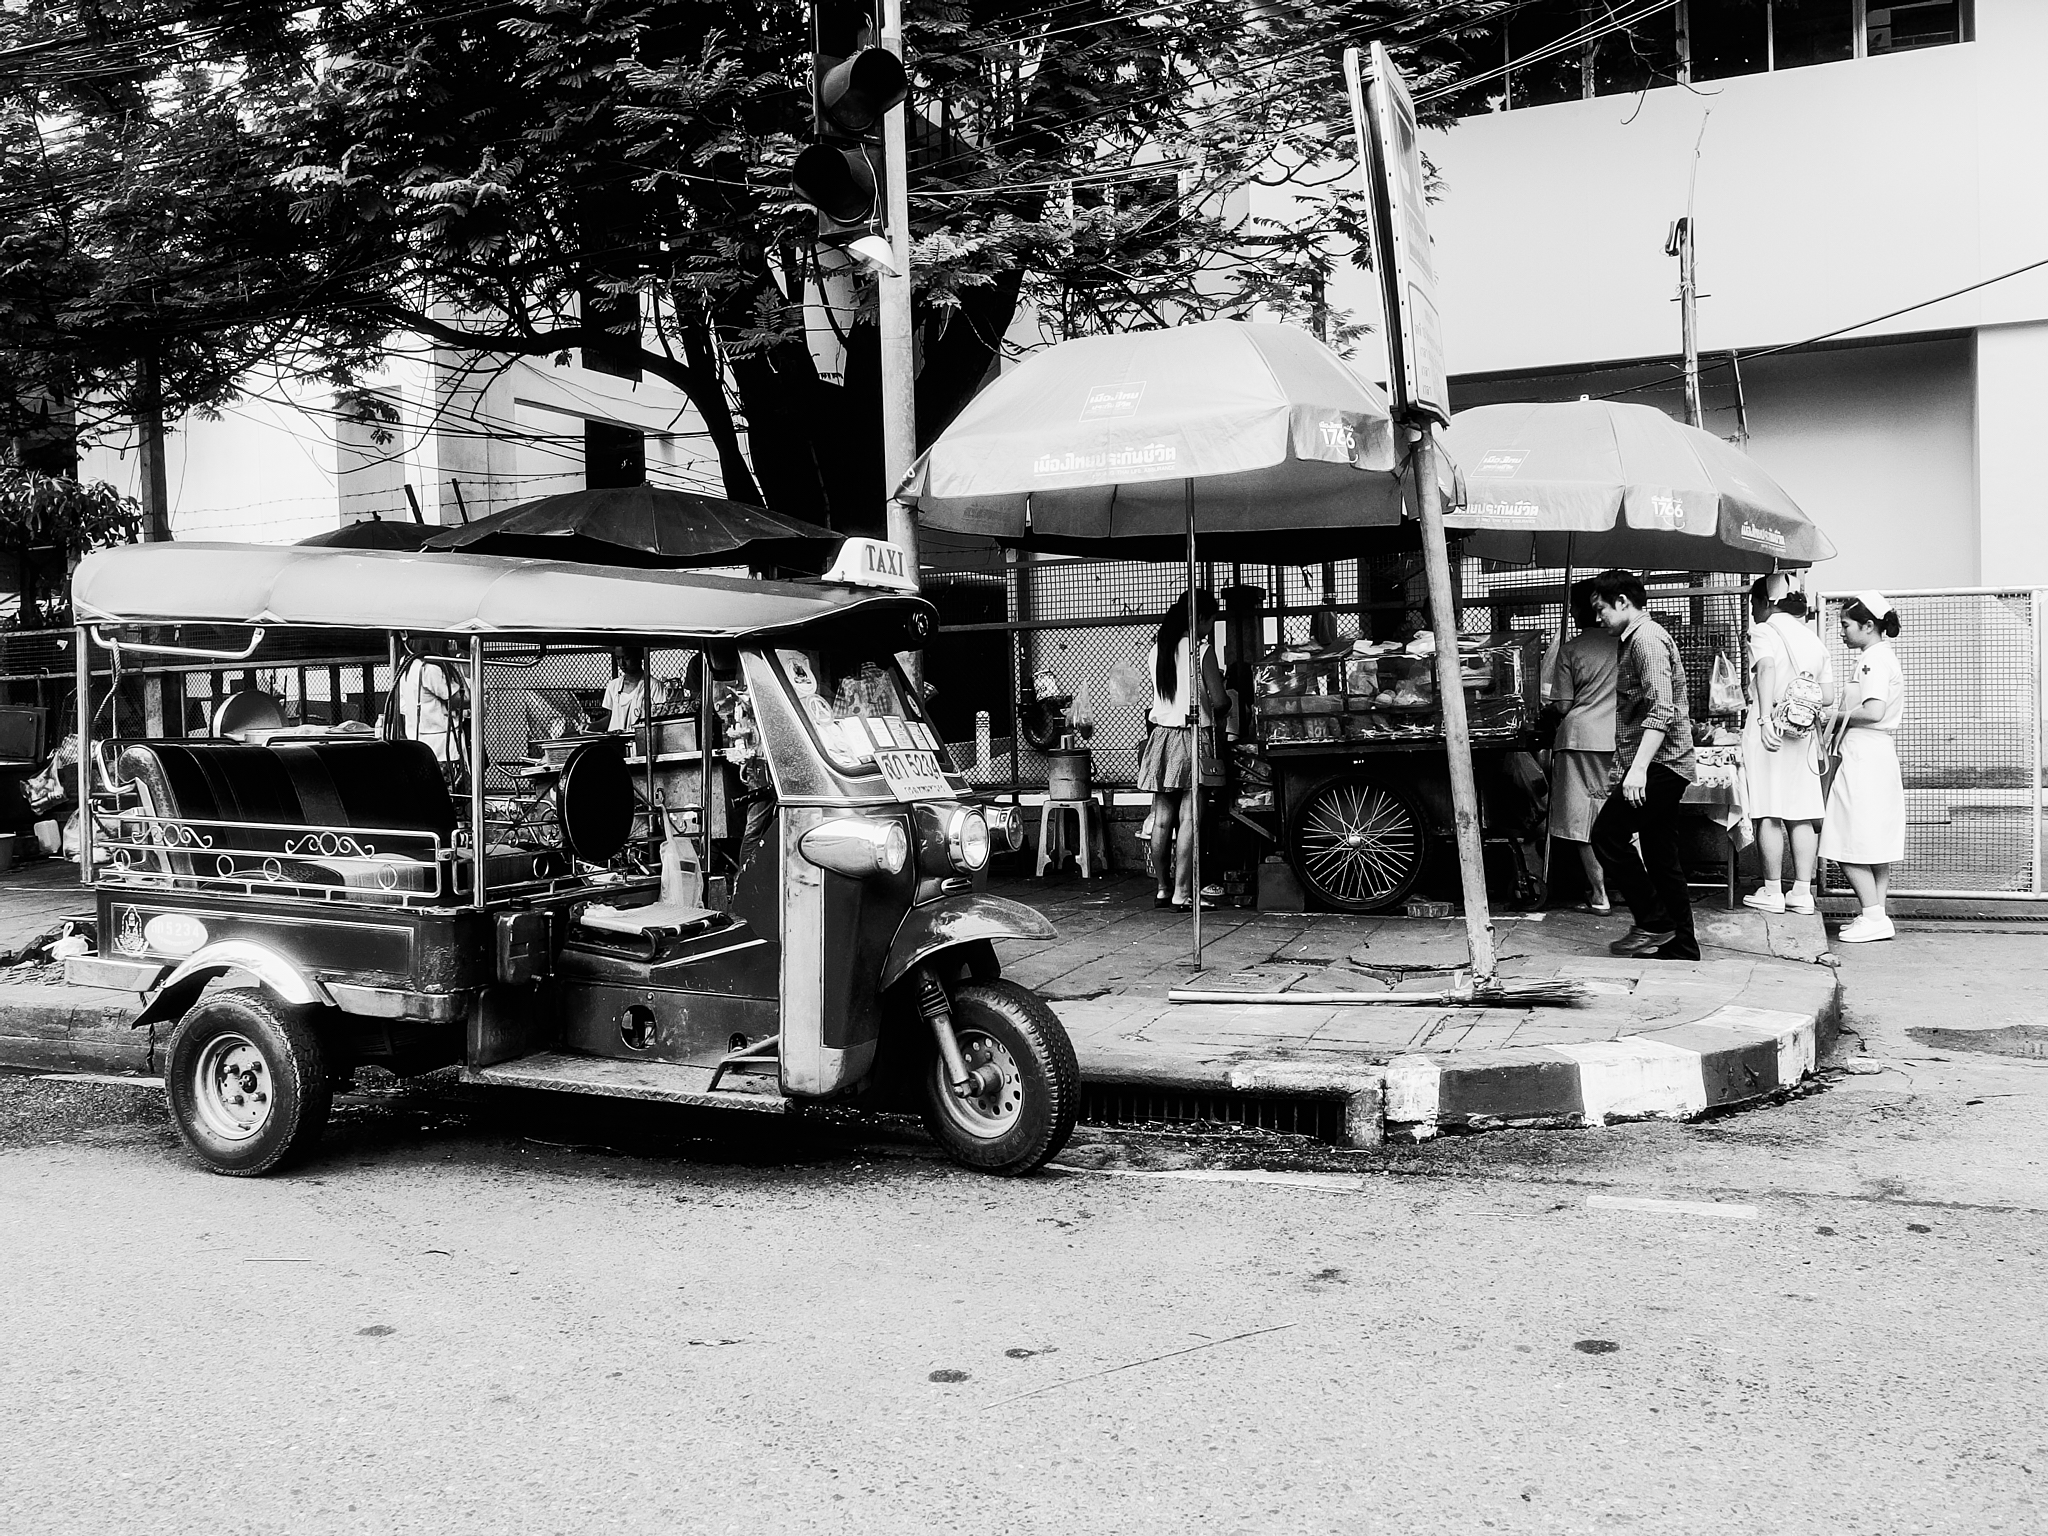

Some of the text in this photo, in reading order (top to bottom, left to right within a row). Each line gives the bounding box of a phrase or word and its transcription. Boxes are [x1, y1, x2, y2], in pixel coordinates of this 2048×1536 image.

[1320, 428, 1356, 449] 1766
[1033, 443, 1176, 473] เมืองไทยประกันชีวิต
[1651, 501, 1684, 518] 1766
[865, 544, 904, 577] TAXI
[905, 753, 942, 780] 5234
[166, 921, 199, 938] 5234
